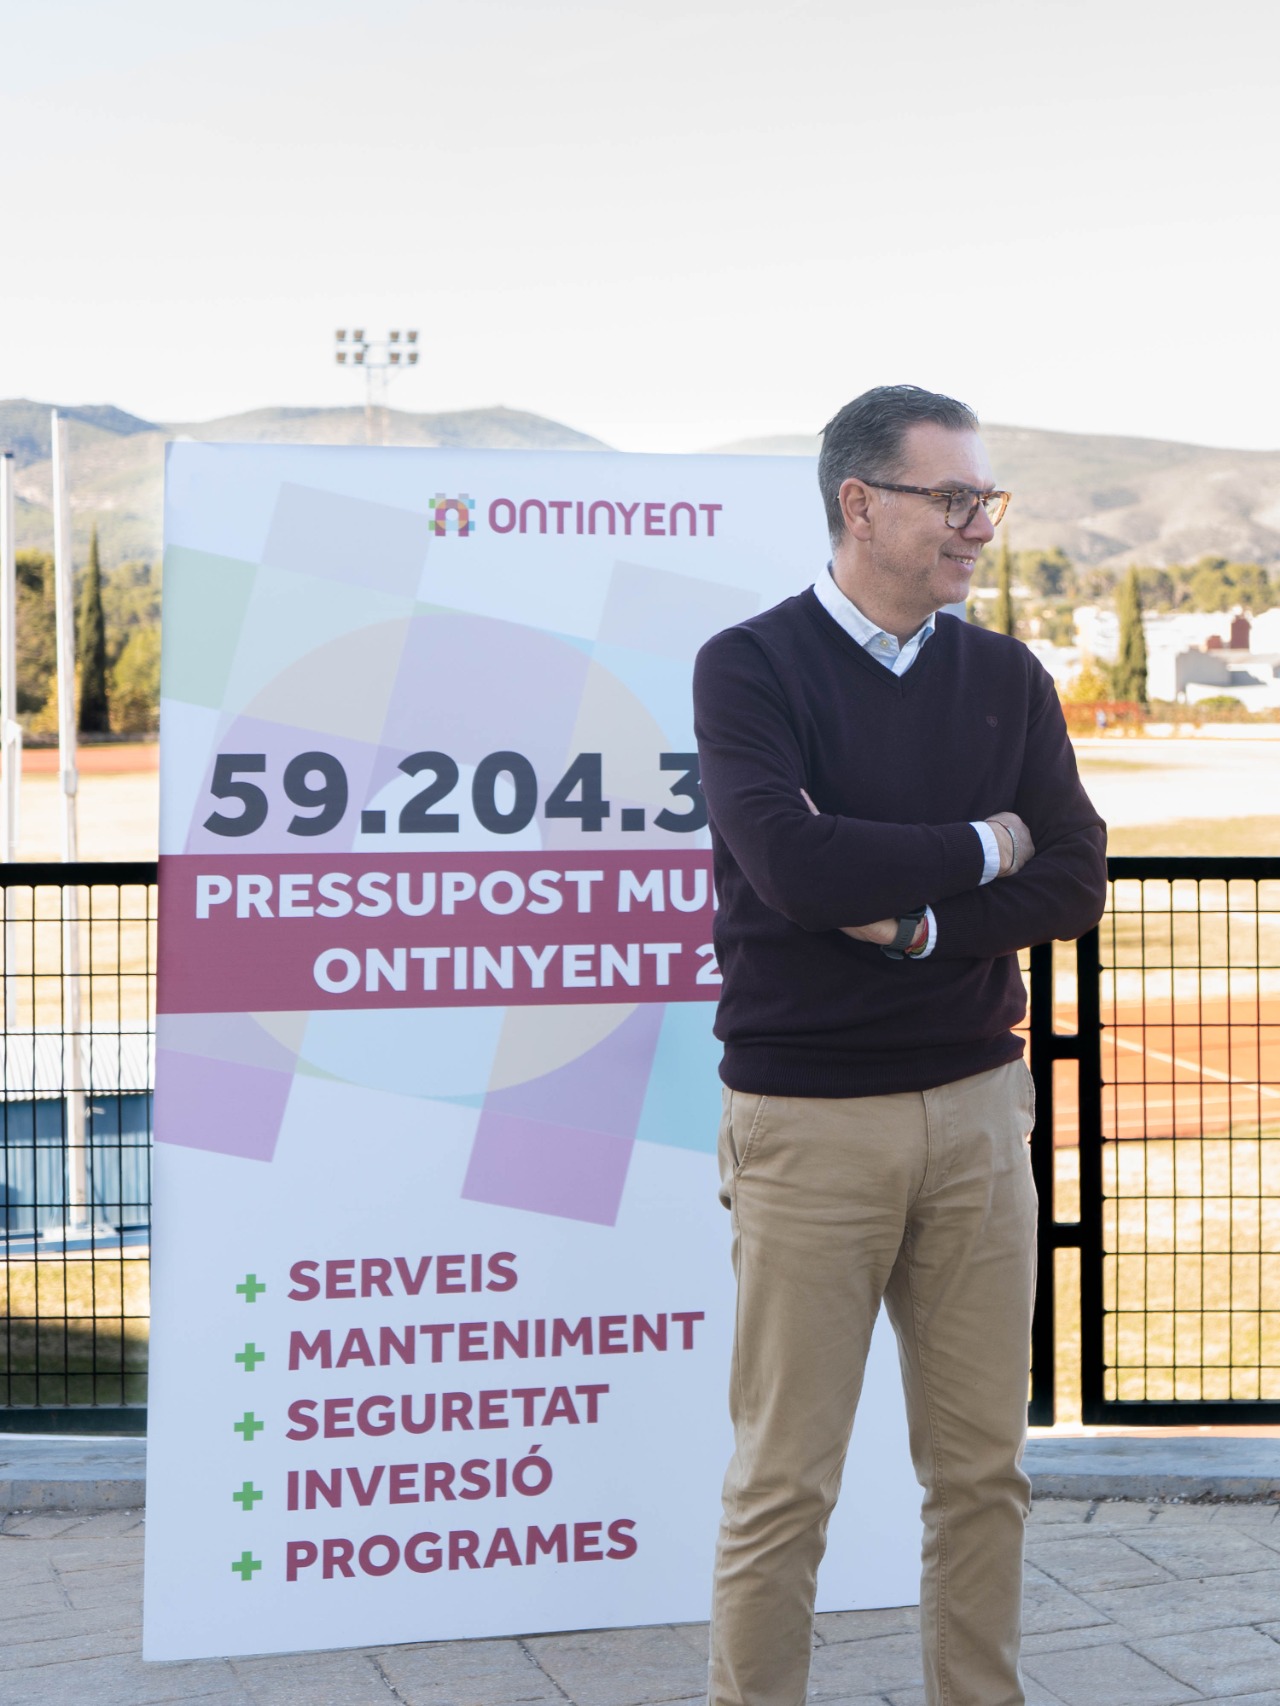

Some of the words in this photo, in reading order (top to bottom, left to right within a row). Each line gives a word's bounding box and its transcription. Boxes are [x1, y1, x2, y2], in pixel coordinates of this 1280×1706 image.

[488, 497, 723, 537] ONTINYENT
[195, 869, 604, 919] PRESSUPOST
[313, 942, 682, 994] ONTINYENT
[287, 1251, 518, 1302] SERVEIS
[288, 1311, 705, 1371] MANTENIMENT
[285, 1383, 610, 1442] SEGURETAT
[287, 1443, 553, 1511] INVERSIÓ
[286, 1518, 638, 1582] PROGRAMES
